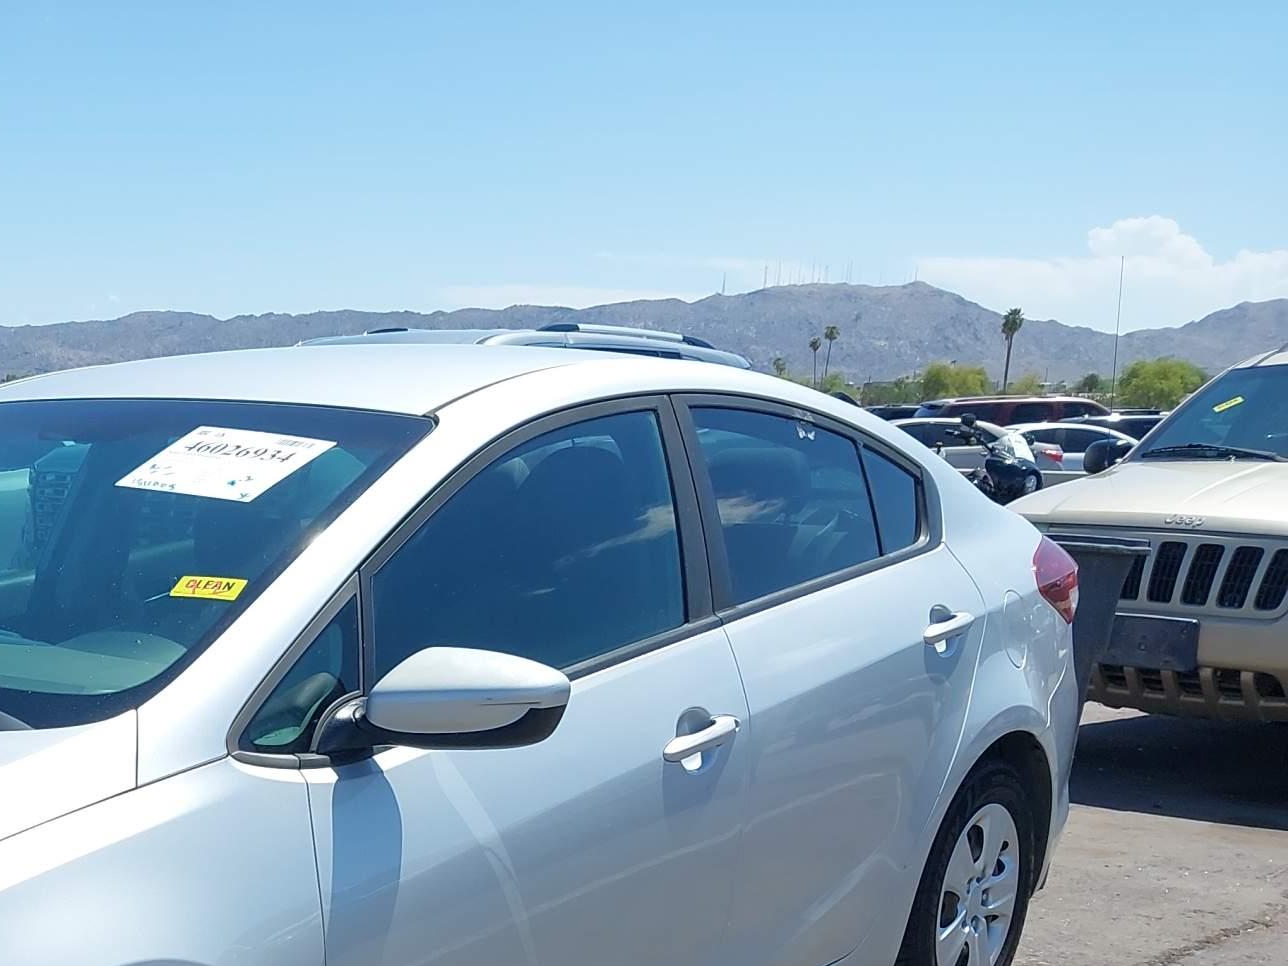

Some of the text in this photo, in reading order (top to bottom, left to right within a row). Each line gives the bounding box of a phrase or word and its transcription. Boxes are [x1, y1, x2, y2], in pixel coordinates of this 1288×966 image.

[184, 439, 298, 464] 46026934
[1165, 513, 1207, 528] Jeep
[185, 578, 236, 592] CLEAN
